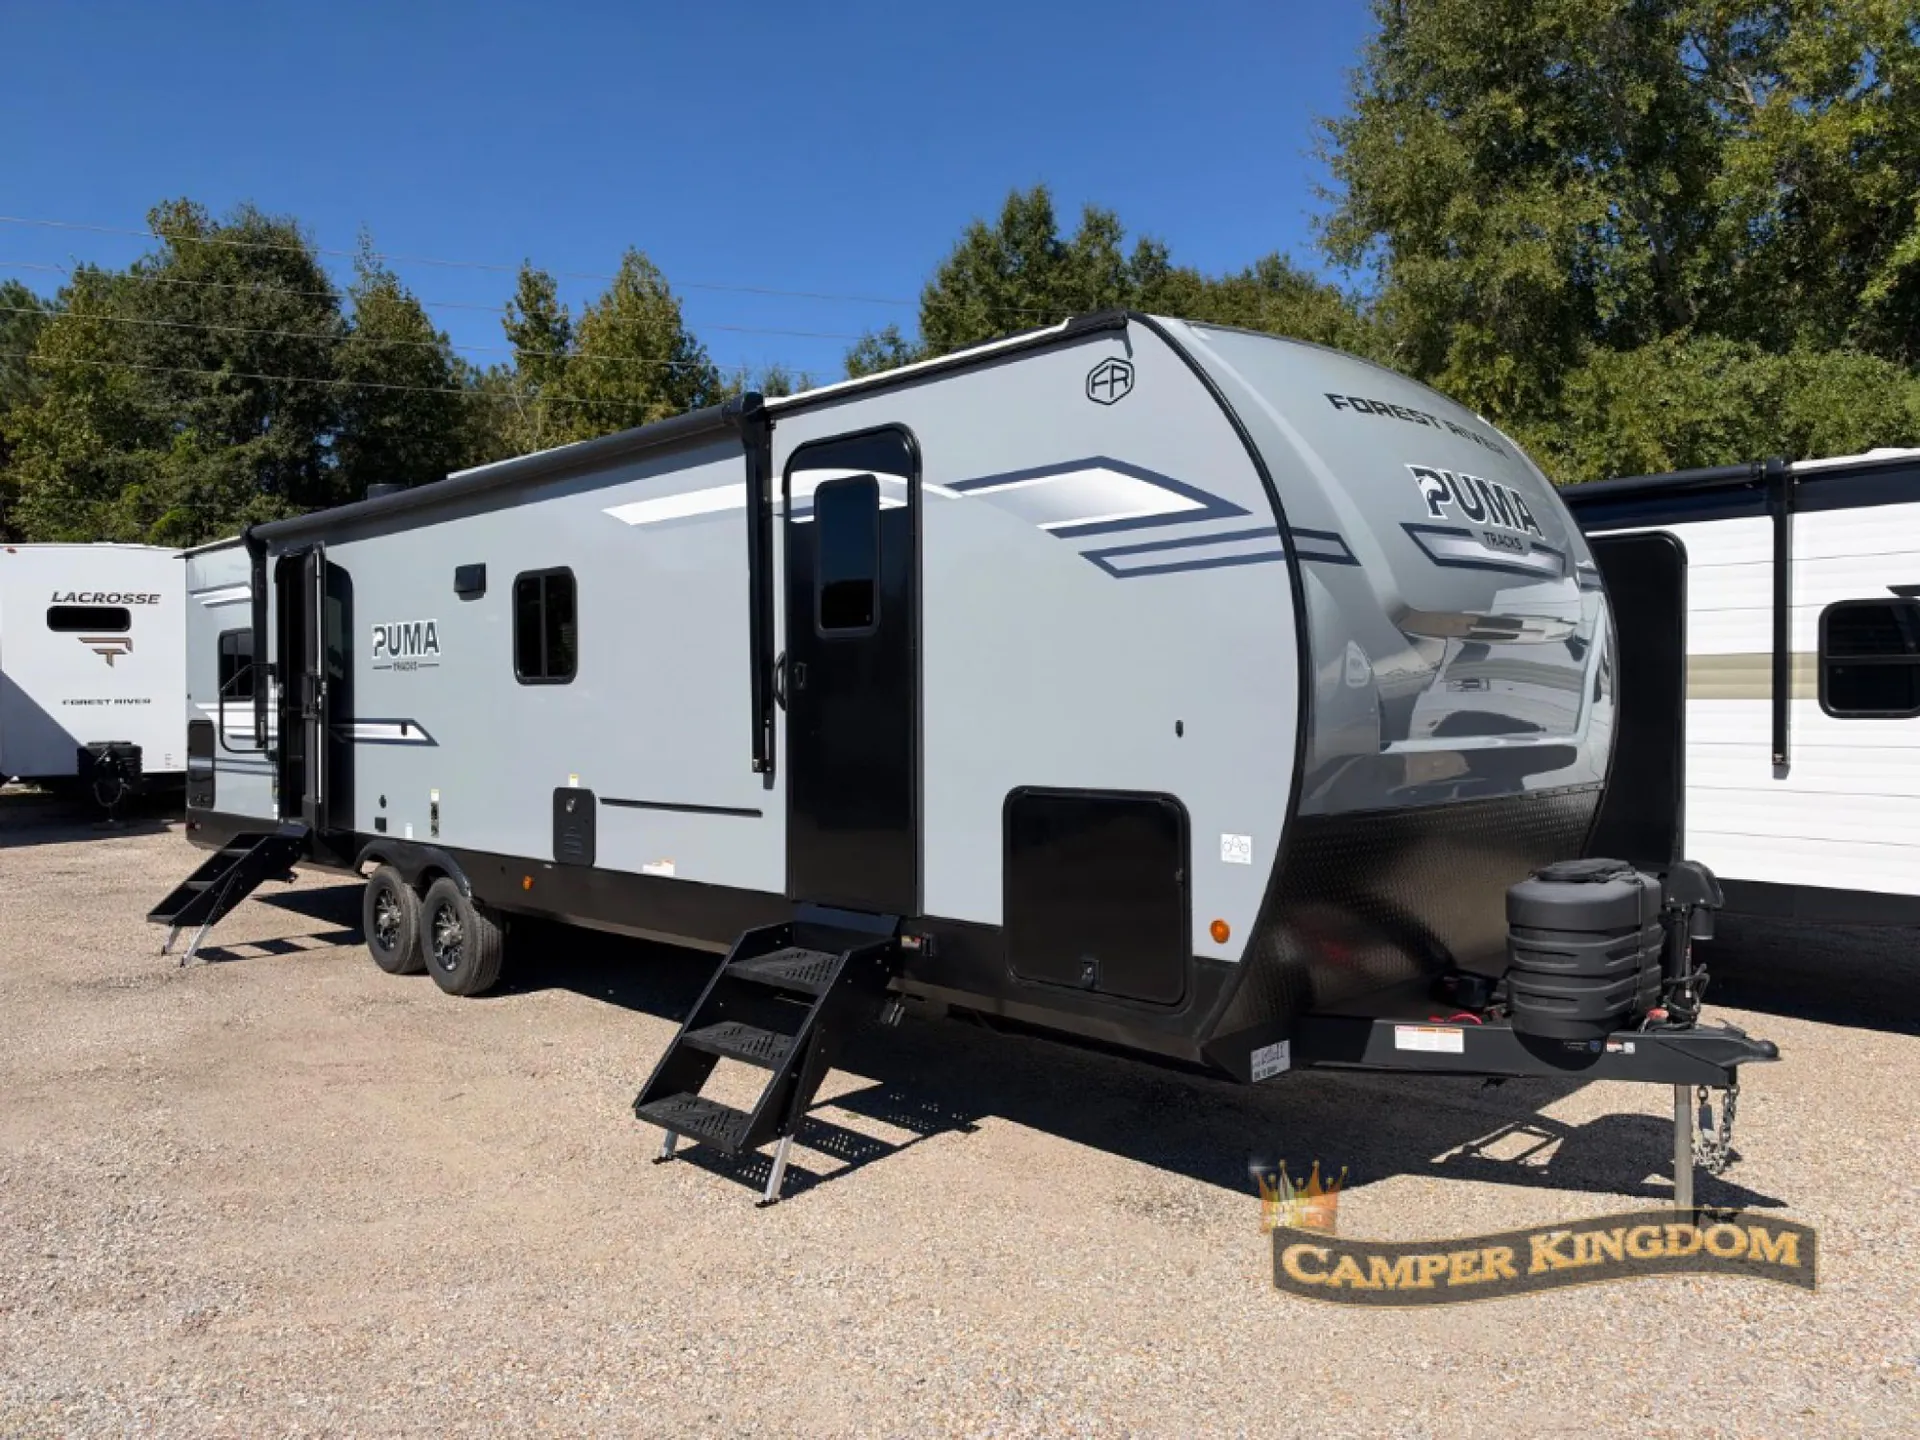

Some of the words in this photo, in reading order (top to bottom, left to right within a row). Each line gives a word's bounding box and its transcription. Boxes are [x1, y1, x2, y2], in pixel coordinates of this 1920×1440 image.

[1324, 393, 1443, 430] FOREST
[1404, 463, 1546, 541] PUMA
[1483, 531, 1523, 551] TRACKS
[50, 591, 162, 605] LACROSSE
[371, 618, 441, 659] PUMA
